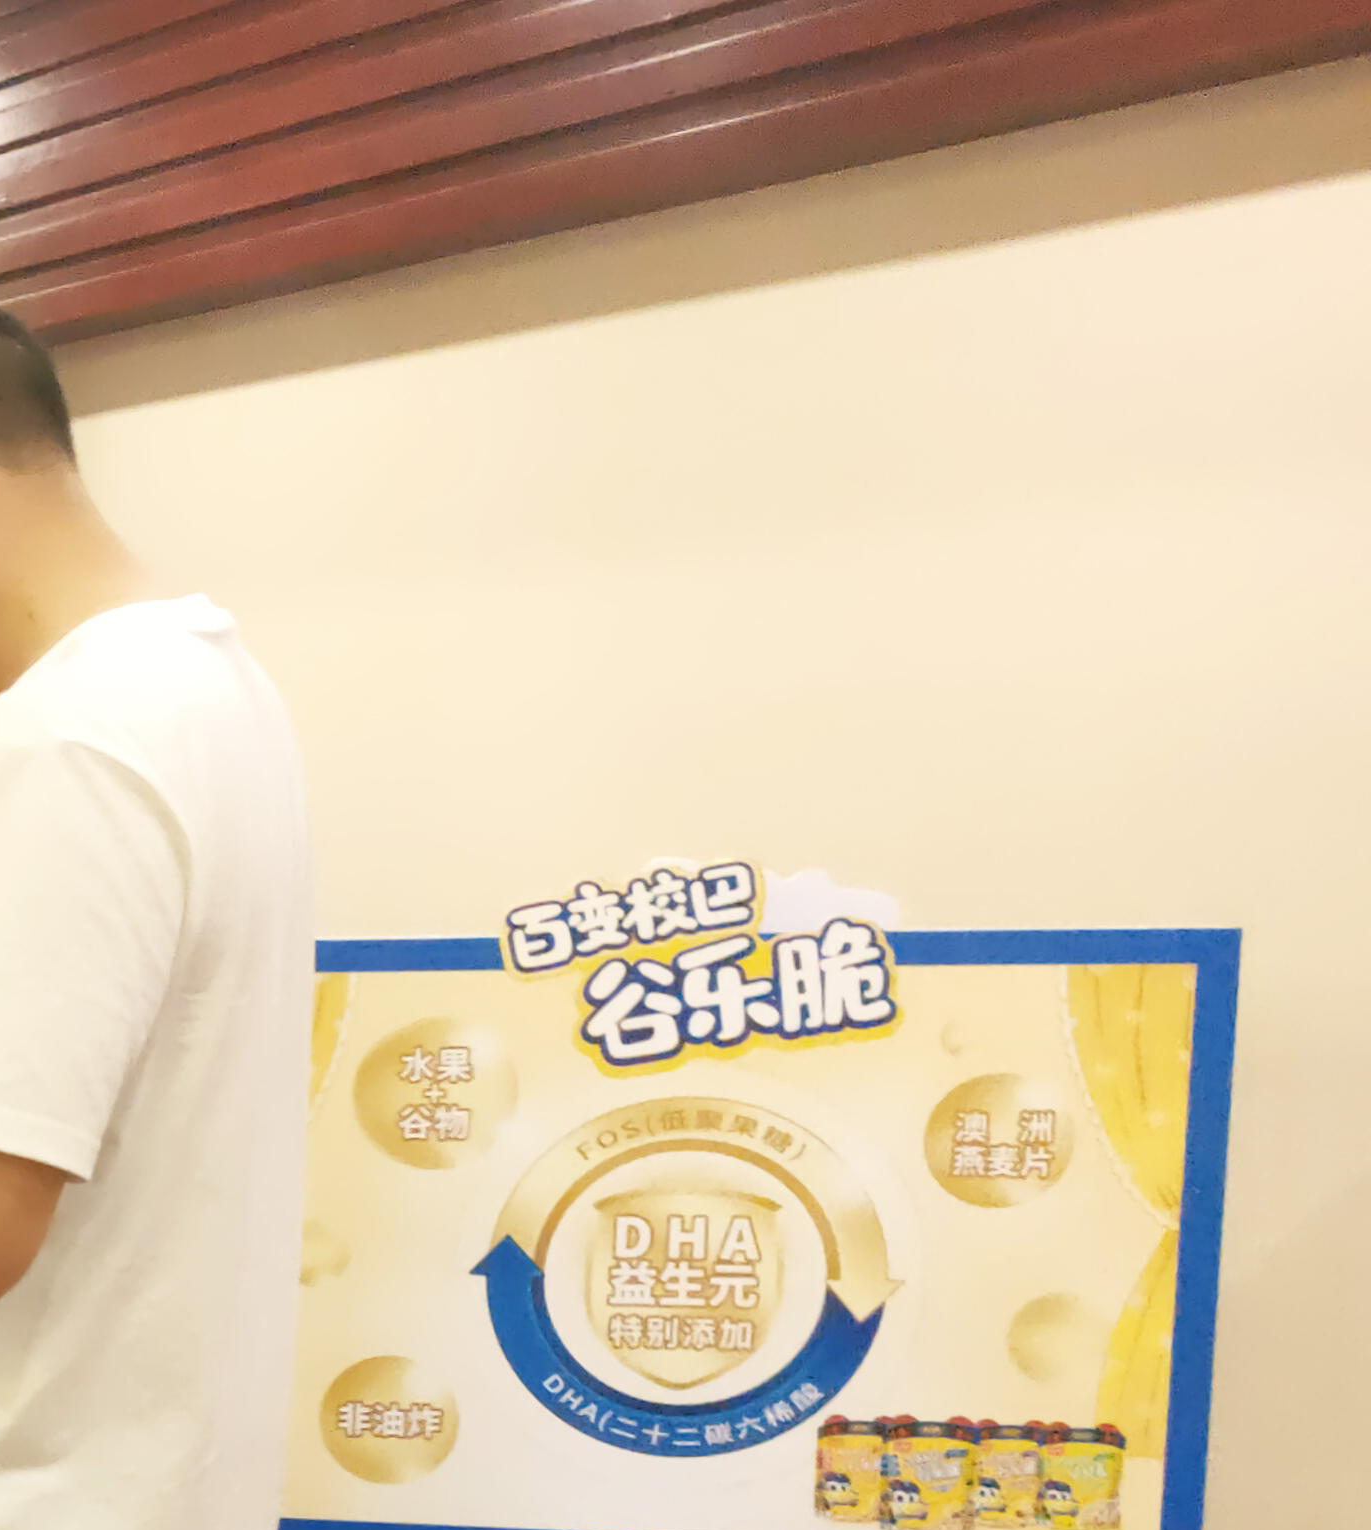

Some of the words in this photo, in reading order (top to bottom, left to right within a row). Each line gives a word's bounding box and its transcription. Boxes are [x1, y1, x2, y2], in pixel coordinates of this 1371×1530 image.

[507, 862, 757, 972] 百变校巴
[581, 917, 899, 1064] 谷乐脆
[399, 1045, 474, 1084] 水果
[397, 1104, 471, 1141] 谷物
[950, 1143, 1055, 1180] 燕麦片
[614, 1213, 761, 1262] DHA
[606, 1260, 759, 1309] 益生元
[608, 1313, 755, 1352] 特别添加
[337, 1401, 443, 1440] 非油炸
